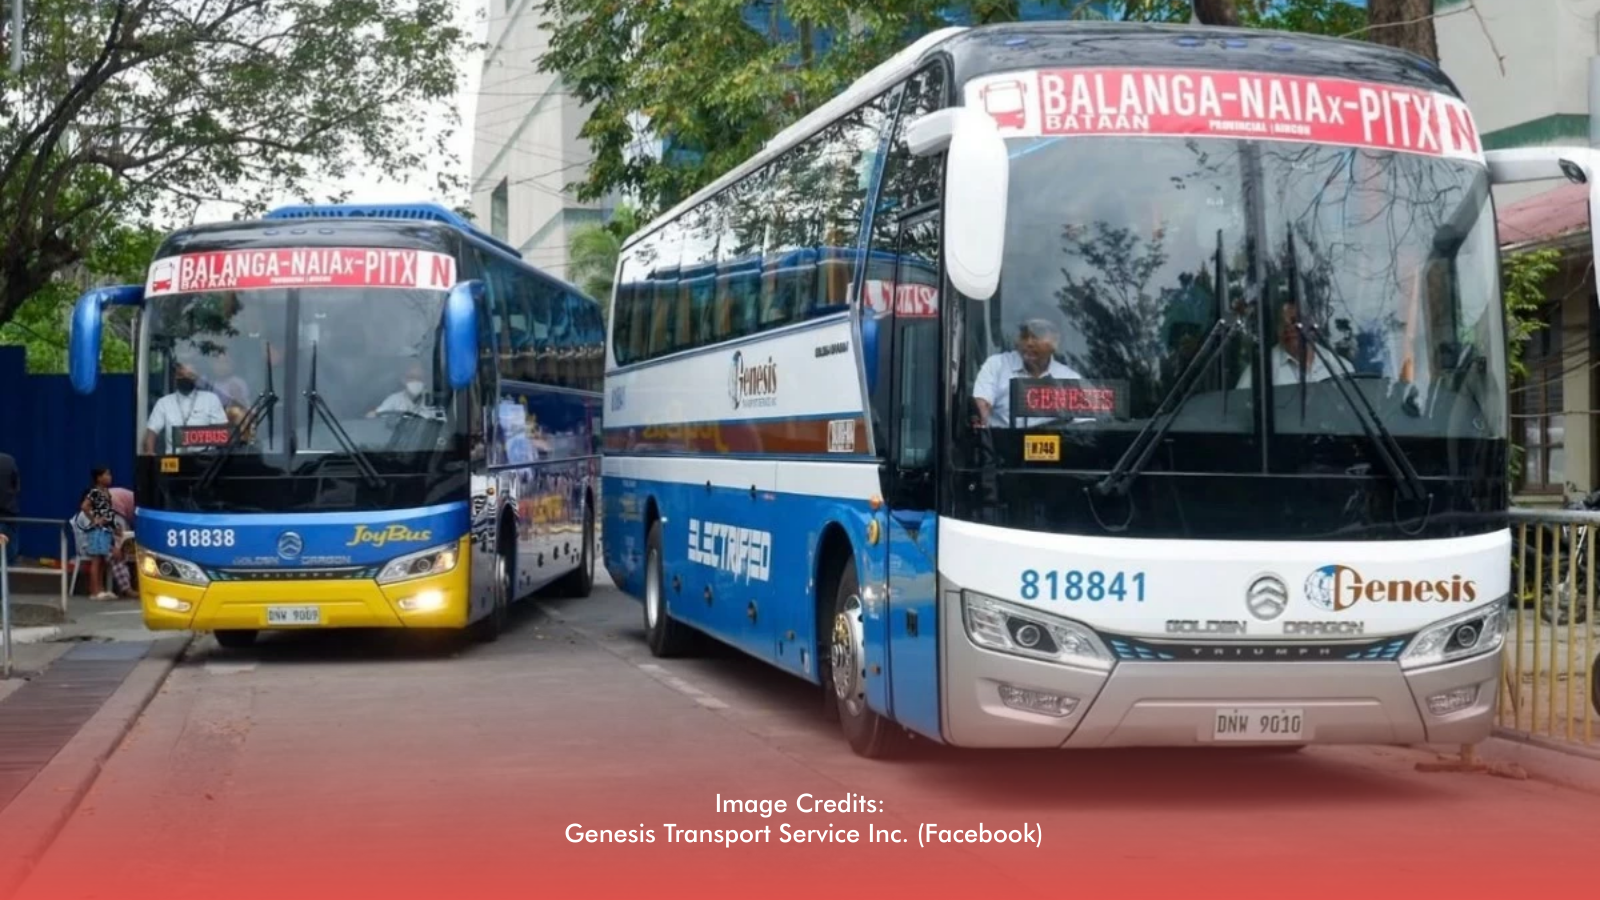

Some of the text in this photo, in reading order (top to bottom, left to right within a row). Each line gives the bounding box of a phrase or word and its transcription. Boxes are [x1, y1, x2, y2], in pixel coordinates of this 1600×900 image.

[1045, 114, 1149, 130] BATAAN
[431, 255, 450, 287] N
[181, 277, 237, 290] BATAAN
[731, 350, 777, 410] Genesis
[1026, 387, 1115, 411] GENESIS
[182, 429, 229, 445] JOYBUS
[167, 528, 235, 548] 818838
[346, 524, 432, 547] JoyBus
[1020, 569, 1145, 602] 818841
[1333, 564, 1477, 612] Genesis
[1283, 621, 1364, 634] DRAGON
[1217, 715, 1300, 733] DNW 9010
